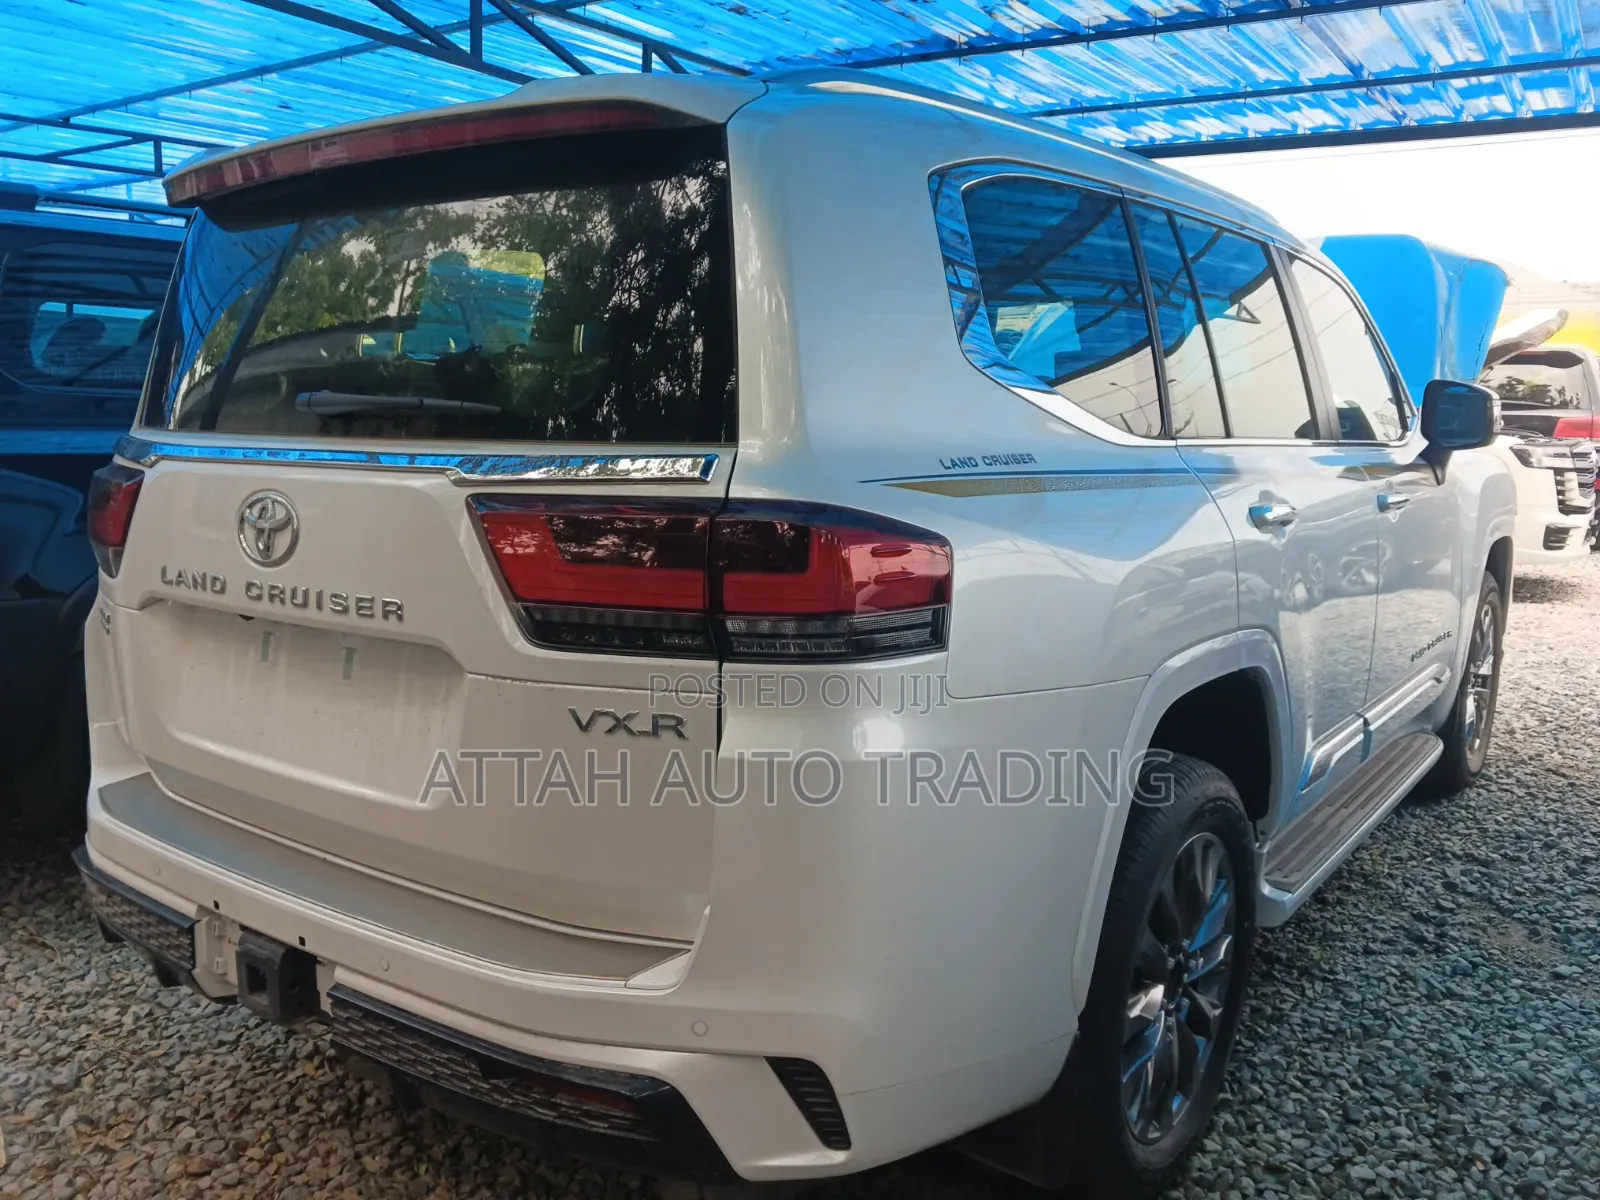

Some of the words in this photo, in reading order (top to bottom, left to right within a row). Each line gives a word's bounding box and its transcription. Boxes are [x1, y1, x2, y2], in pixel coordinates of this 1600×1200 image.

[939, 457, 980, 470] LAND
[981, 453, 1037, 467] CRUISER
[160, 564, 227, 594] LAND
[244, 579, 404, 623] CRUISER
